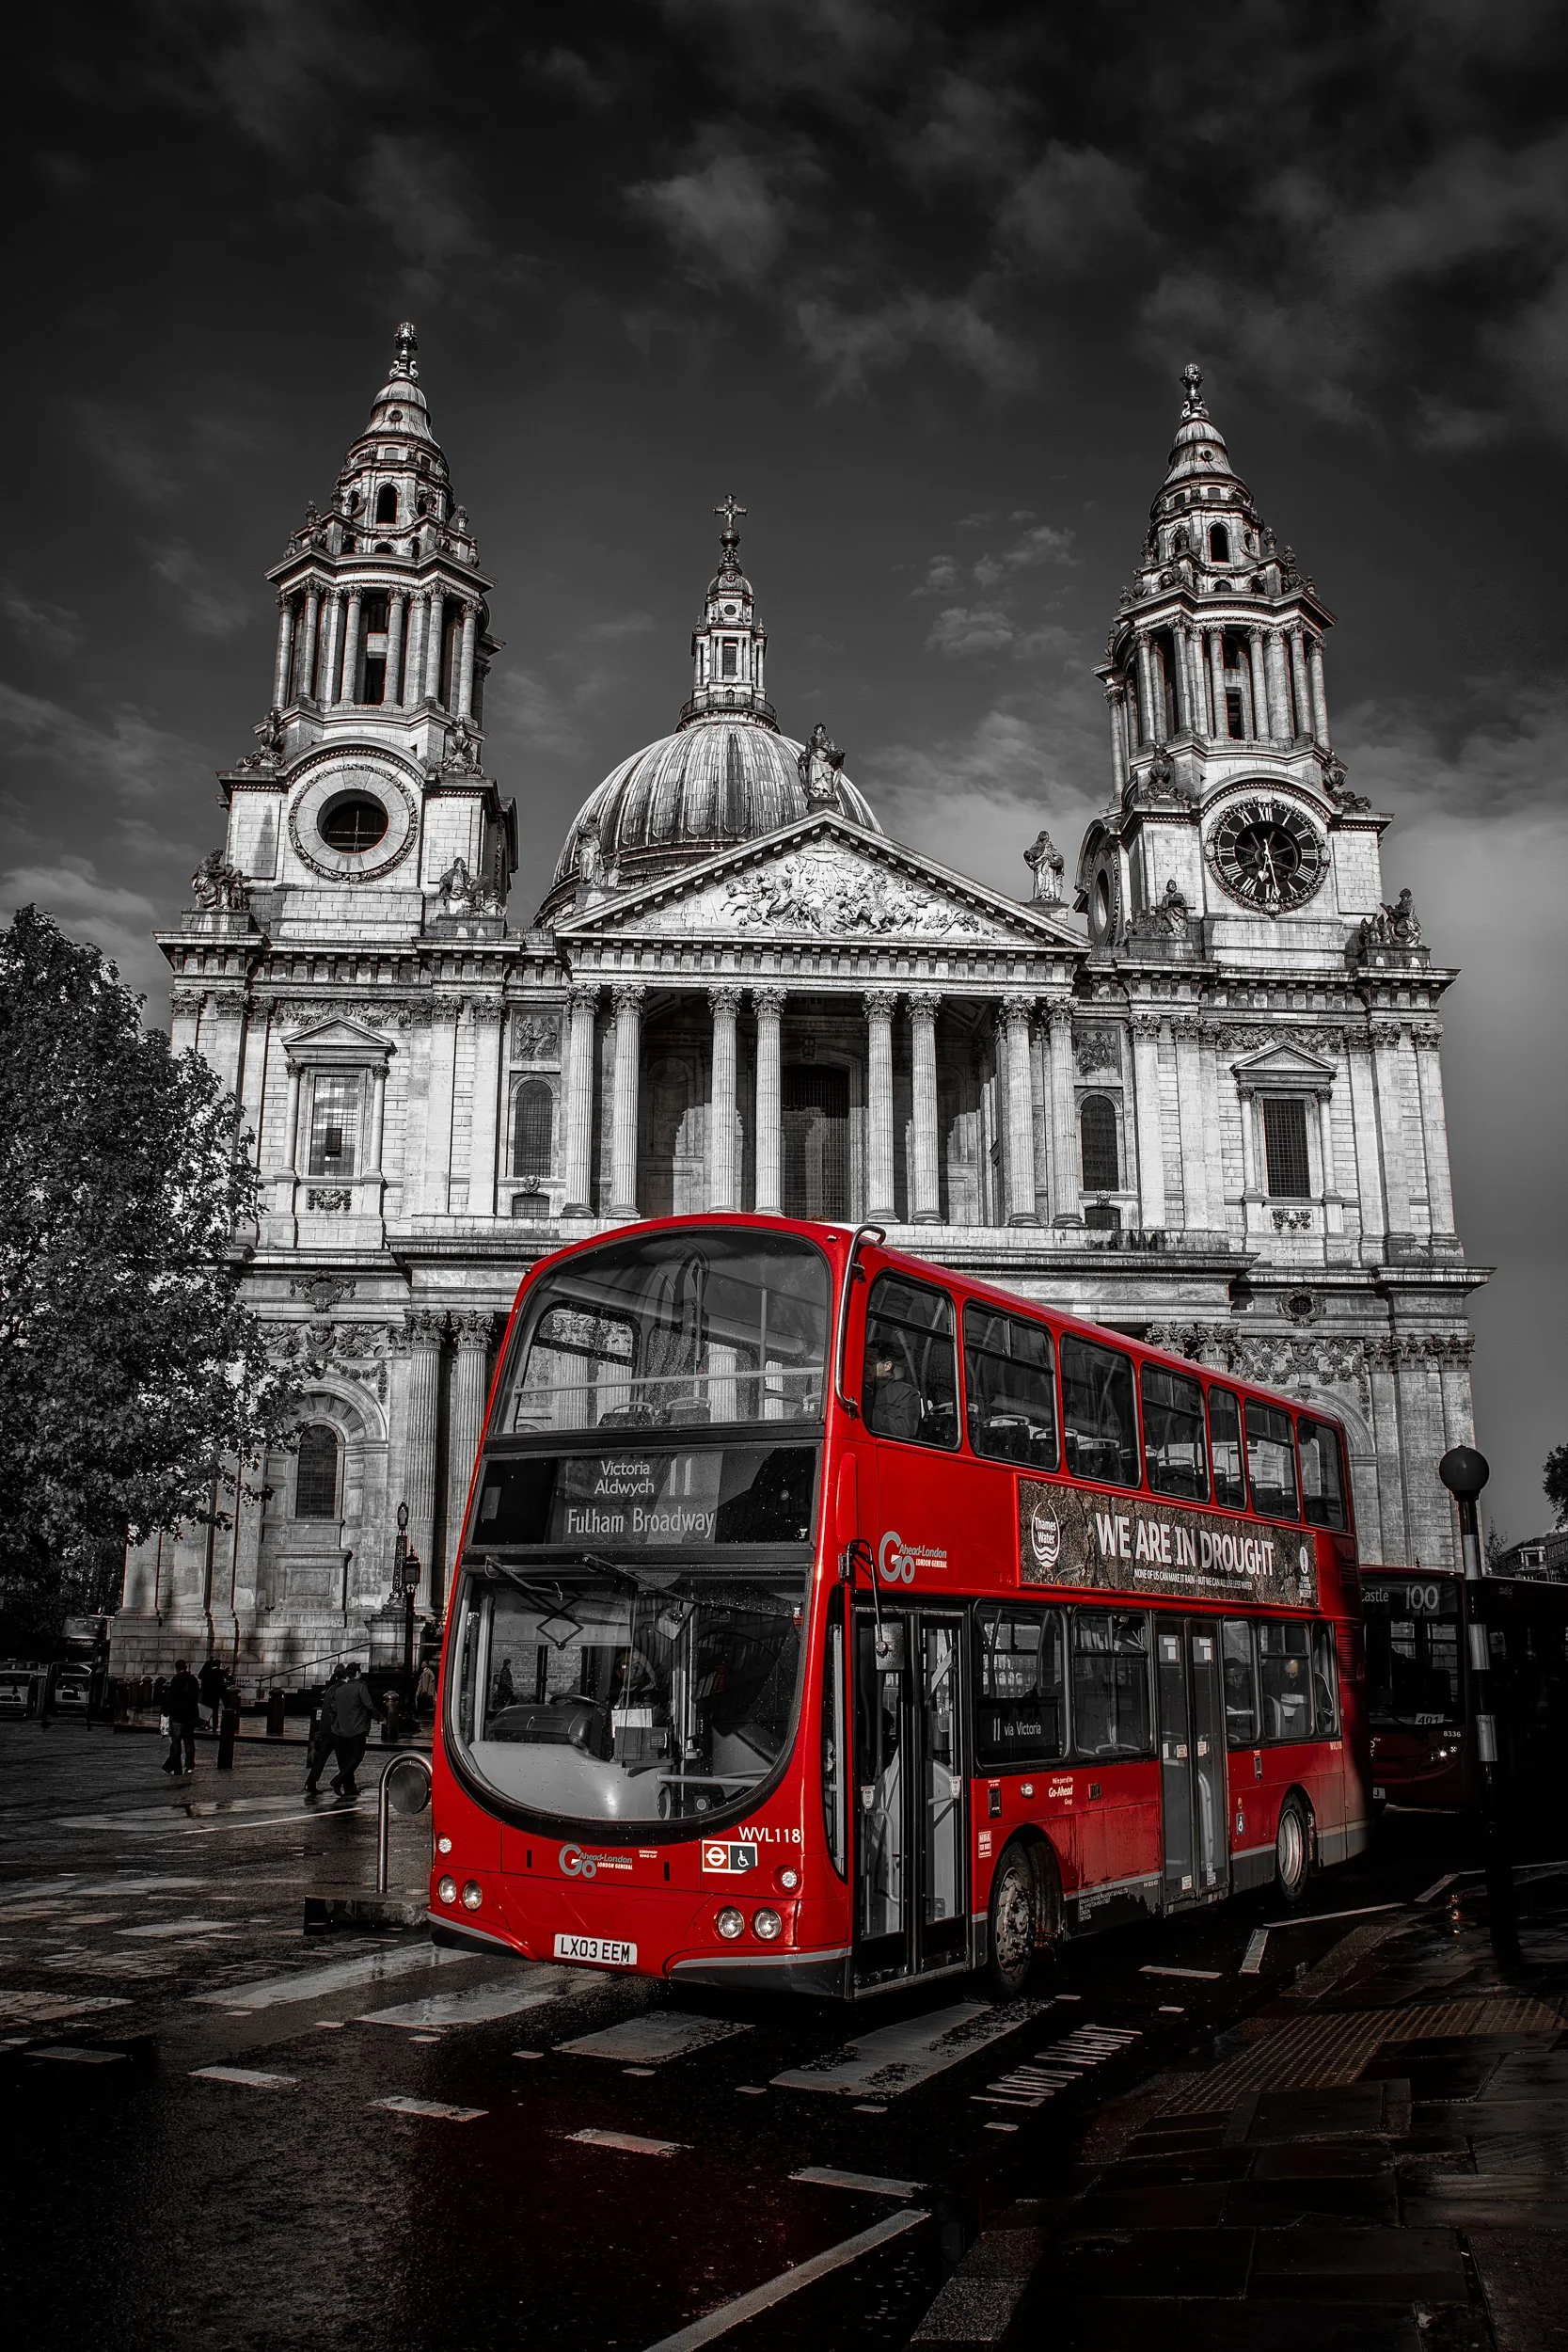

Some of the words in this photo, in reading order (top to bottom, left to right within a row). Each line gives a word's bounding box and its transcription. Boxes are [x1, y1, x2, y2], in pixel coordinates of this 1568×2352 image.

[601, 1460, 651, 1475] Victoria
[669, 1458, 692, 1496] 11
[594, 1478, 655, 1497] Aldwych
[567, 1508, 624, 1534] Fulham
[632, 1505, 715, 1539] Broadway
[1035, 1517, 1056, 1532] Thames
[1037, 1531, 1055, 1545] Water
[1095, 1512, 1131, 1558] WE
[1135, 1519, 1172, 1564] ARE
[1175, 1526, 1196, 1567] IN
[1199, 1530, 1275, 1576] DROUGHT
[879, 1531, 915, 1584] Go
[898, 1544, 947, 1559] Ahead-London
[1133, 1568, 1148, 1579] NONE
[1148, 1569, 1153, 1580] OF
[1153, 1570, 1159, 1581] US
[1160, 1571, 1169, 1581] CAN
[1168, 1572, 1180, 1582] MAKE
[1406, 1585, 1439, 1610] 100
[993, 1717, 1001, 1741] 11
[1004, 1724, 1014, 1737] via
[1016, 1721, 1041, 1736] Victoria
[1048, 1784, 1073, 1797] Go-Ahead
[738, 1826, 801, 1844] WVL118
[559, 1844, 597, 1878] Go
[578, 1852, 632, 1864] Ahead-London
[561, 1937, 598, 1959] LX03
[602, 1942, 630, 1963] EEM
[969, 2065, 1085, 2107] LOOK
[1034, 2023, 1144, 2065] RIGHT
